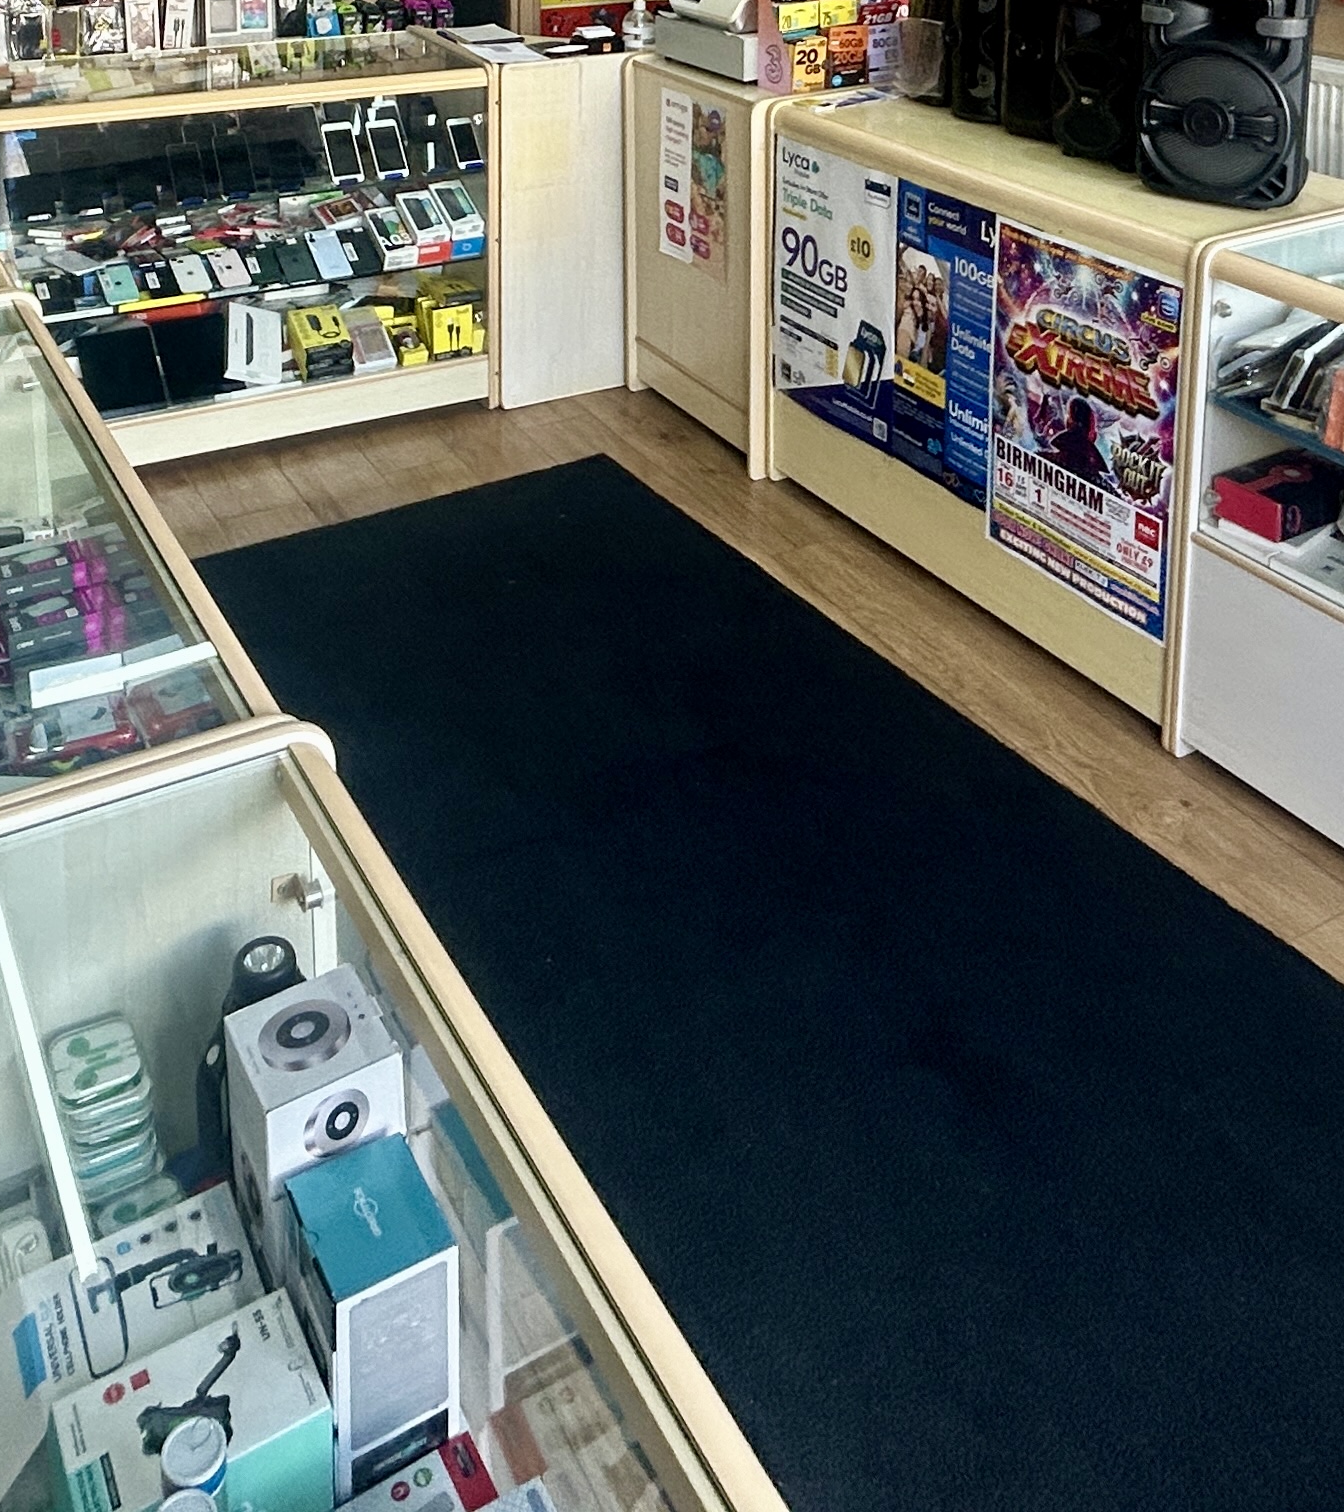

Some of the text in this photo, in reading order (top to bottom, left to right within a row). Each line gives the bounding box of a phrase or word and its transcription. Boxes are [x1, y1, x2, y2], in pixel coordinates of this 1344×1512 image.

[863, 10, 893, 24] 21GB
[796, 49, 818, 65] 20
[834, 51, 865, 65] 20GB
[806, 65, 821, 75] GB
[782, 146, 809, 171] Lyca
[782, 188, 833, 221] Triple Data
[928, 202, 960, 222] Connect
[850, 236, 870, 258] £10
[781, 226, 848, 293] 90GB
[954, 256, 994, 288] 100GB
[951, 337, 976, 360] Data
[1036, 309, 1131, 366] CIRCUS
[1112, 443, 1167, 480] ROCK IT
[996, 436, 1104, 515] BIRMINGHAM
[997, 467, 1014, 484] 16
[1123, 467, 1147, 489] OUT
[1035, 487, 1042, 503] 1
[1117, 542, 1141, 561] ONLY
[999, 528, 1047, 565] EXCITING
[1072, 570, 1148, 625] PRODUCTION
[44, 1322, 62, 1384] UNIVERSAL
